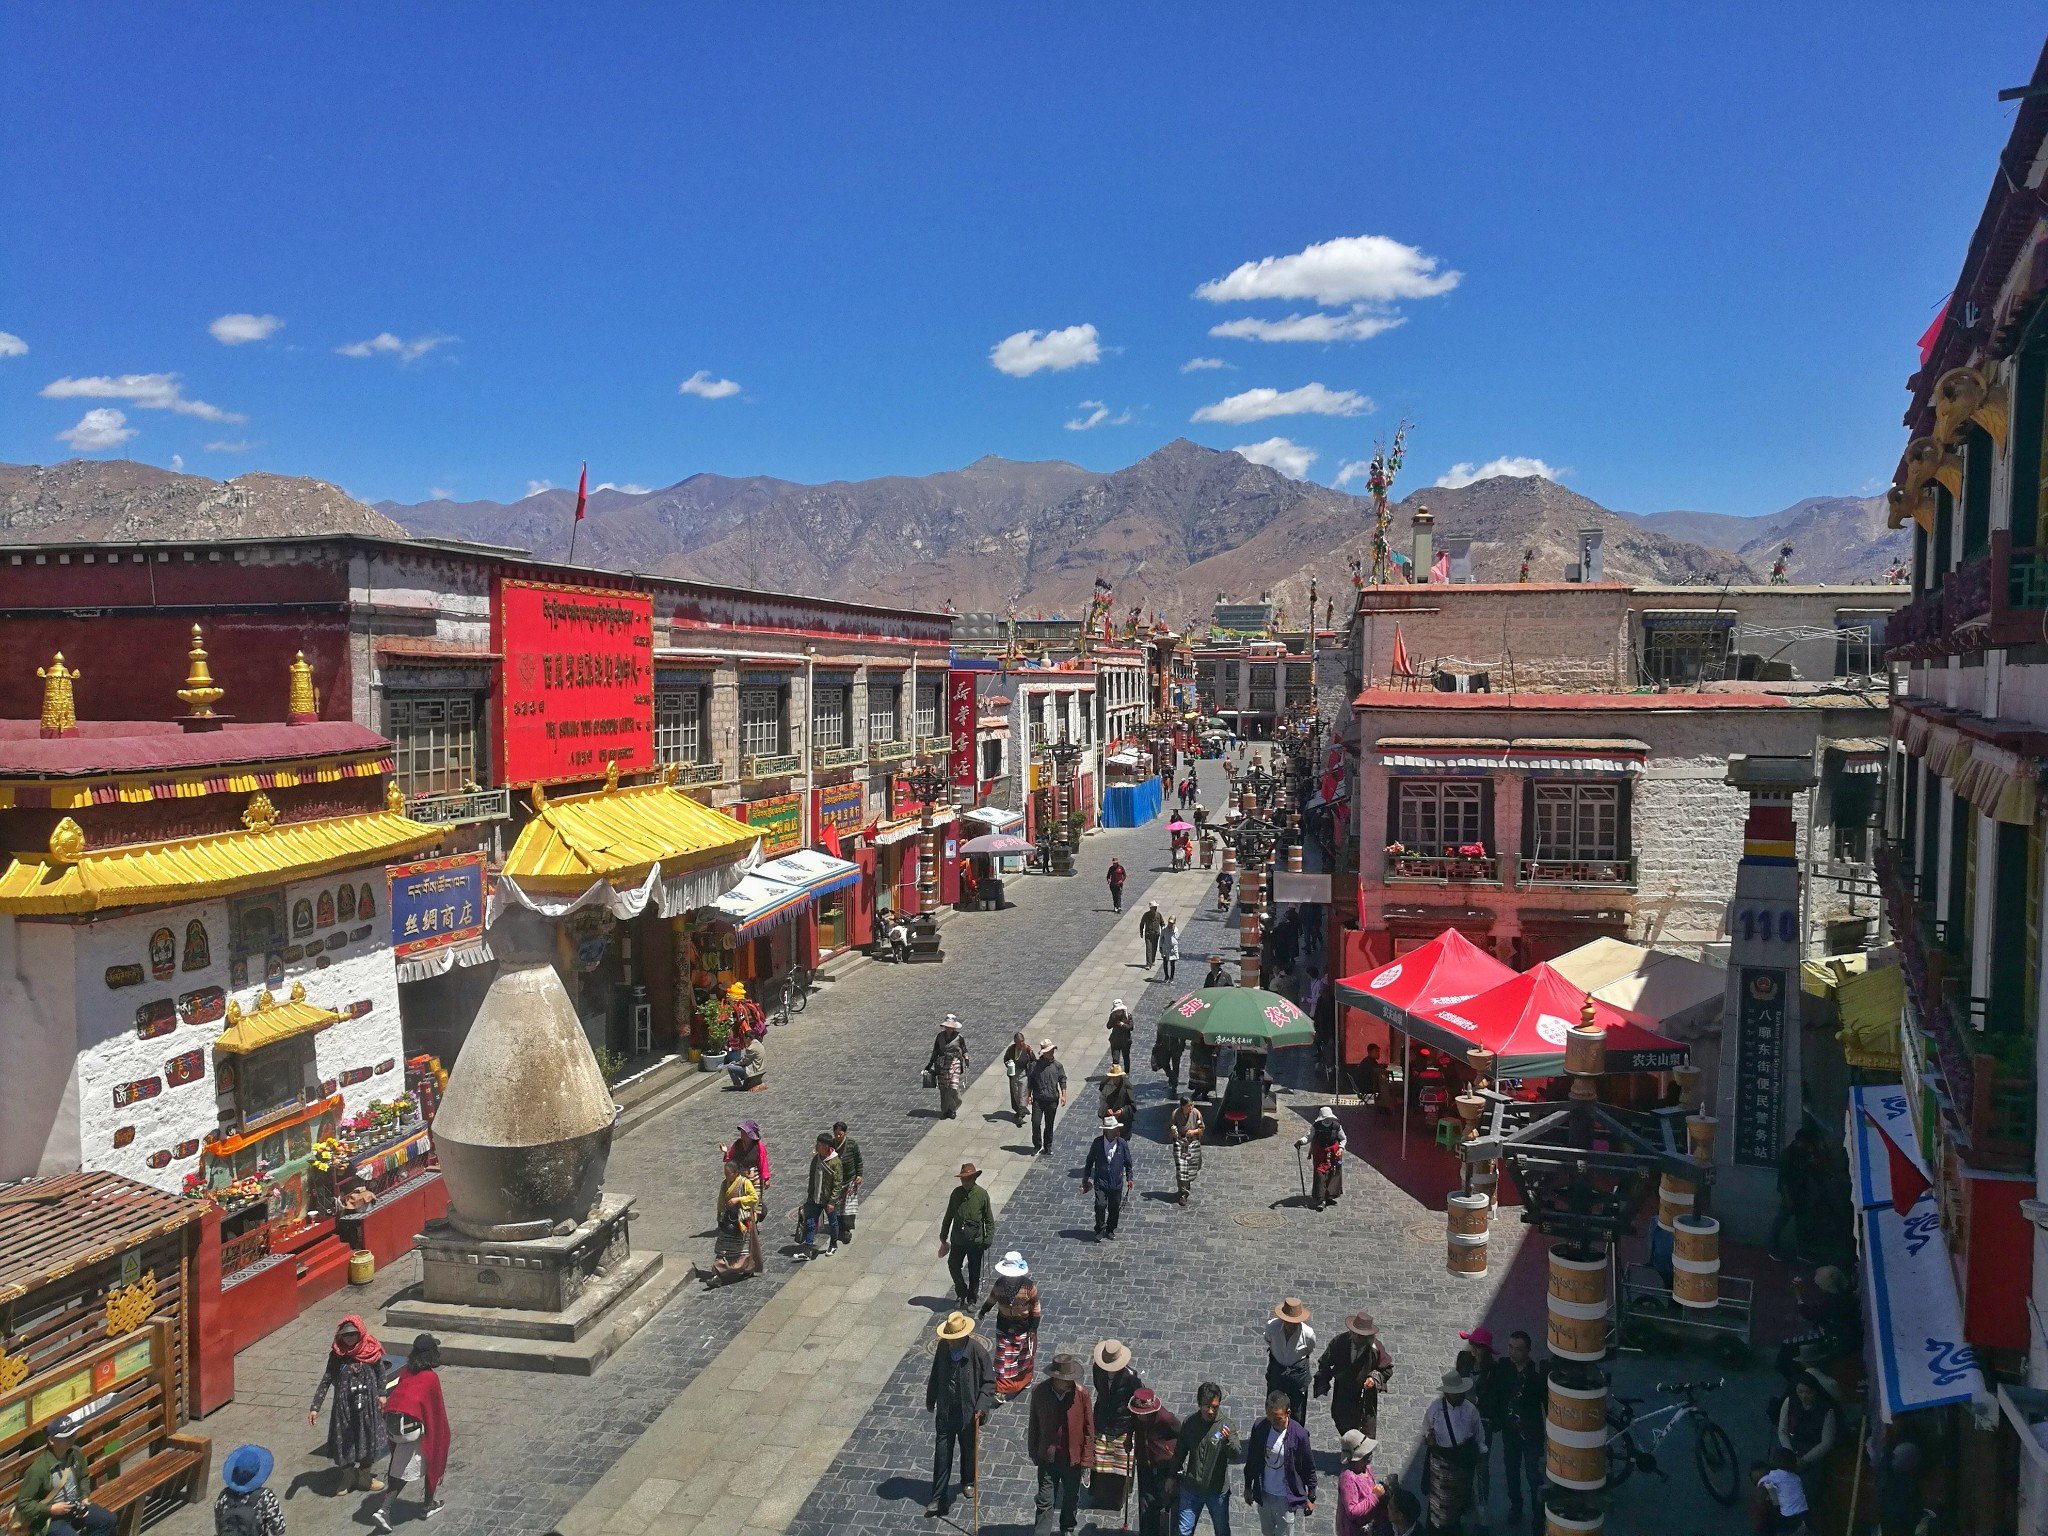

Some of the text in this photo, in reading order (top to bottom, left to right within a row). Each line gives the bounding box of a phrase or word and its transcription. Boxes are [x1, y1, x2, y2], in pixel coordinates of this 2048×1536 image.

[403, 900, 473, 936] 丝绸商店
[1739, 909, 1794, 942] 110
[1632, 1053, 1681, 1067] 农夫山泉
